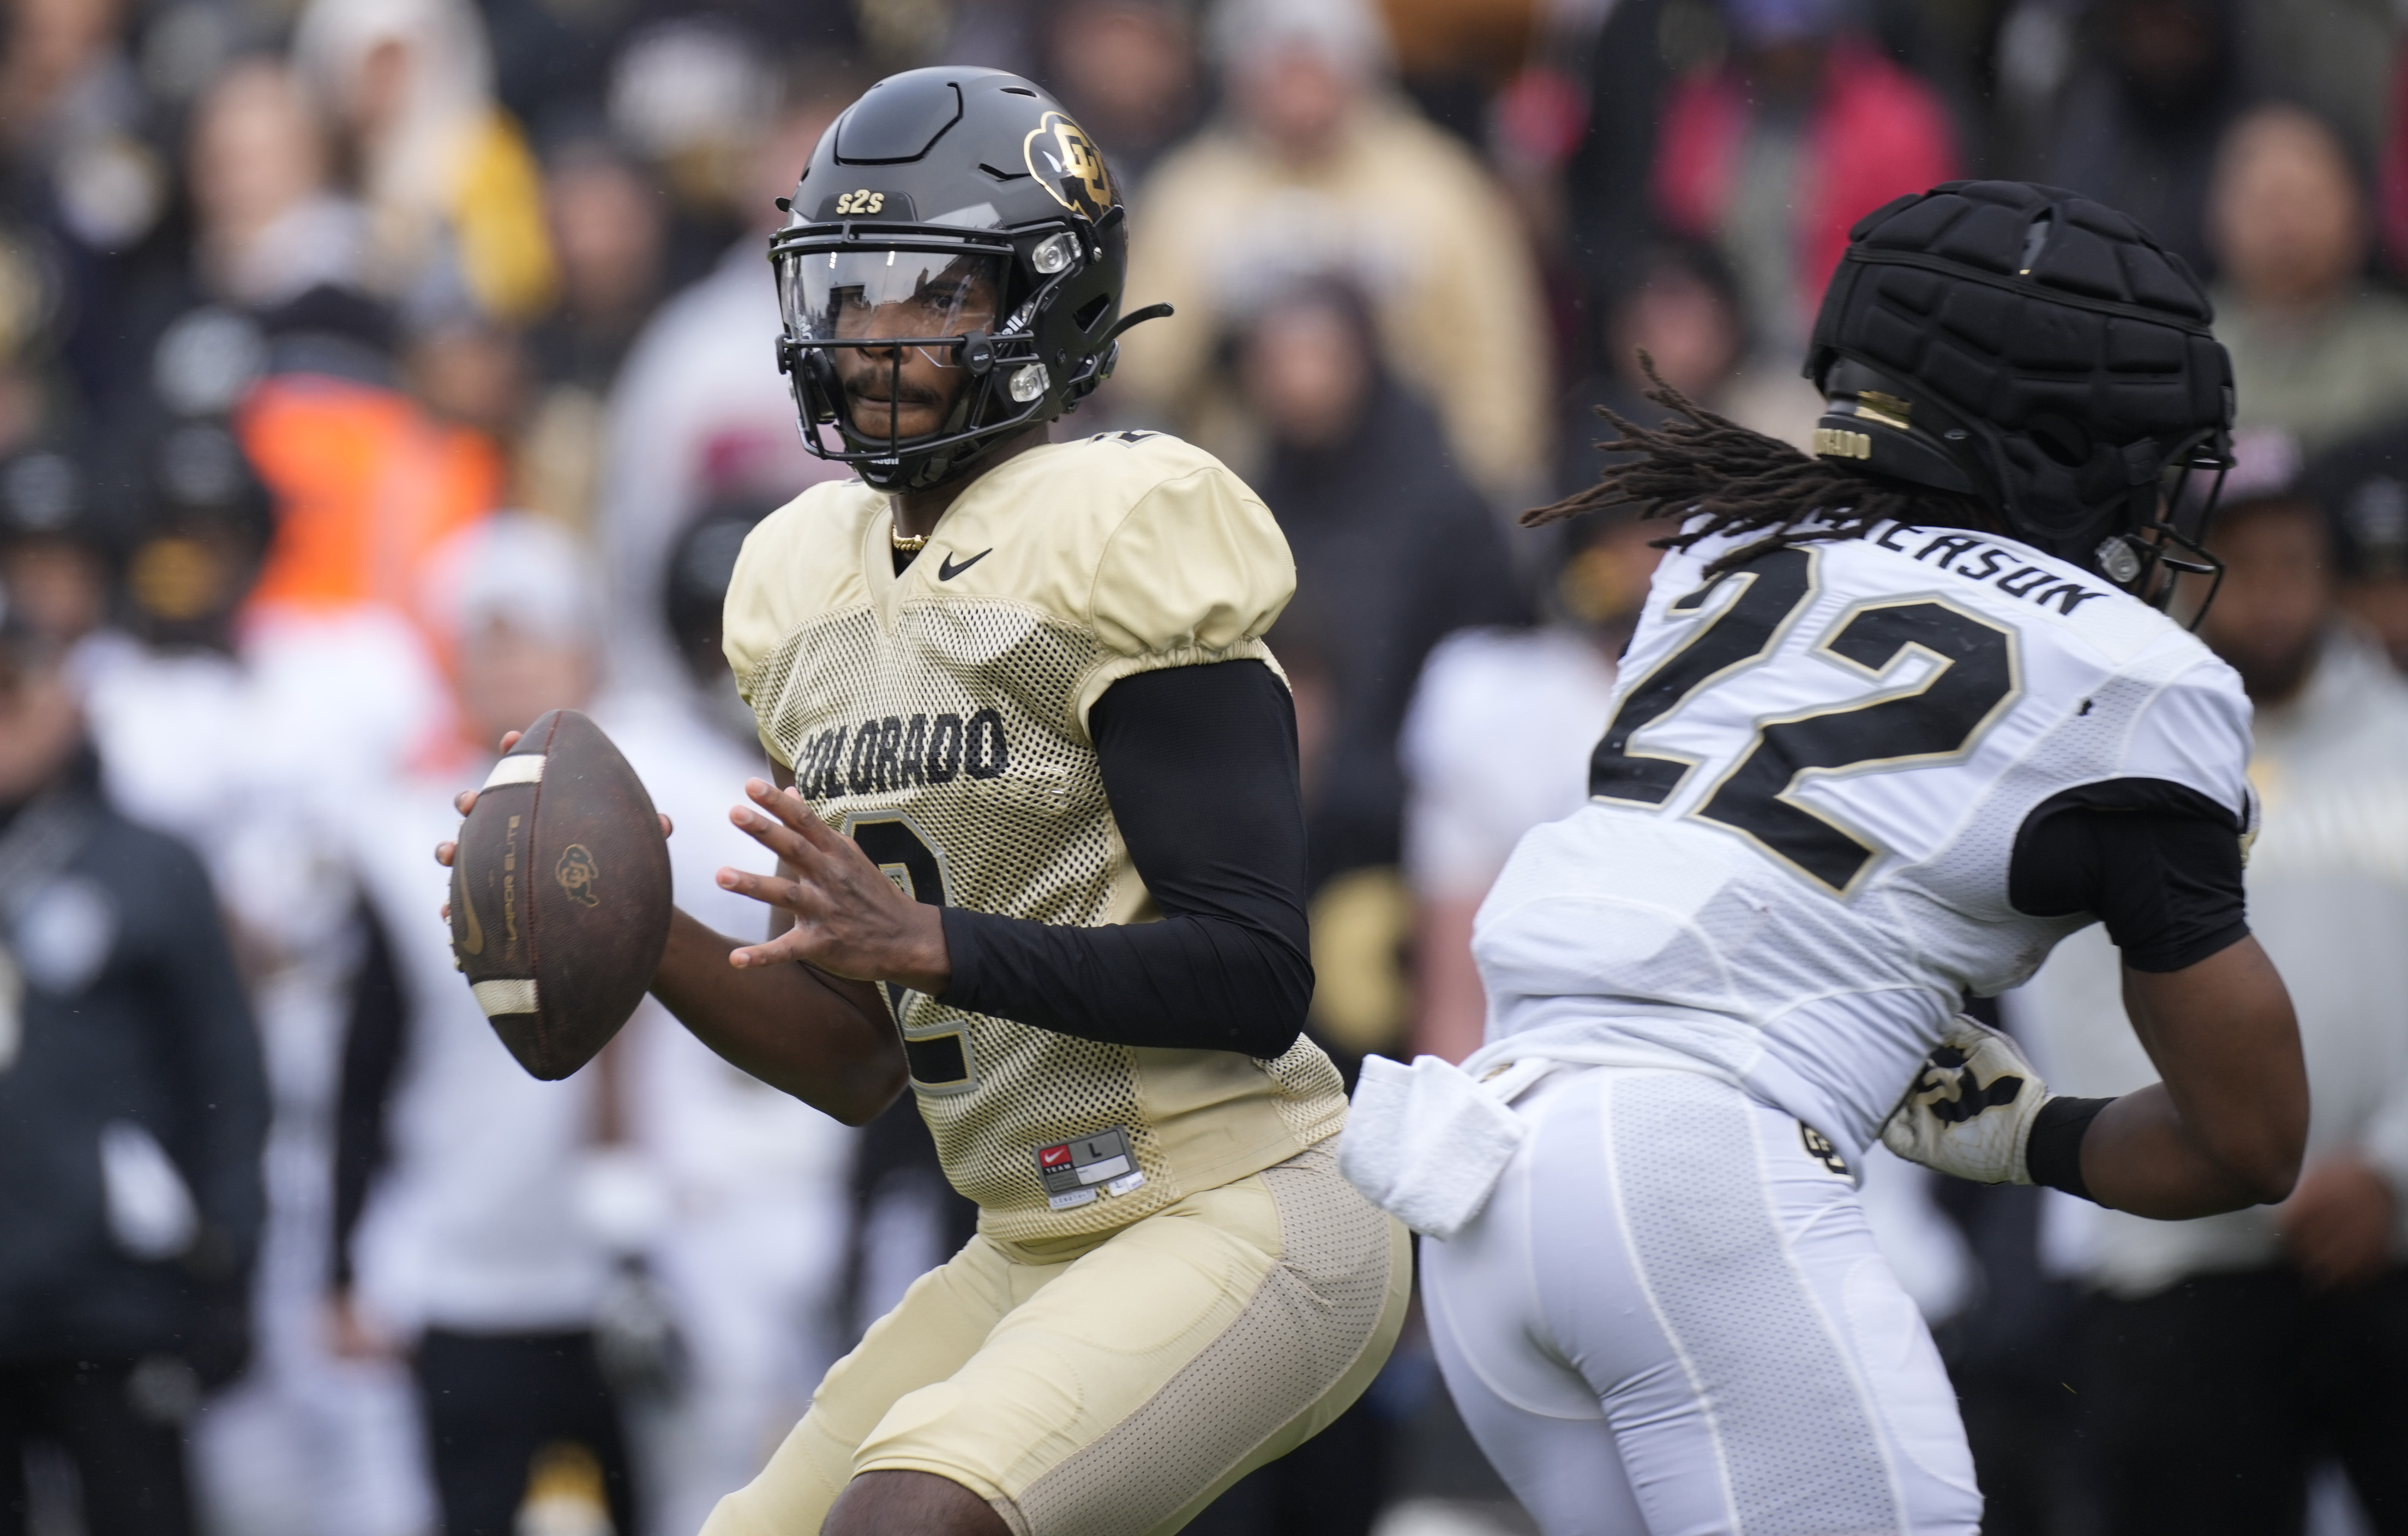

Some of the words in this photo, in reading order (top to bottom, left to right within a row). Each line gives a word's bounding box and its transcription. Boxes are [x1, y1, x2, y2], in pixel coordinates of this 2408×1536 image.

[1588, 536, 2026, 907] 22
[795, 709, 1008, 801] COLORADO
[503, 815, 521, 871] ELITE
[503, 875, 518, 941] VAPOR
[1044, 1163, 1072, 1174] TEAM
[1088, 1142, 1102, 1159] L
